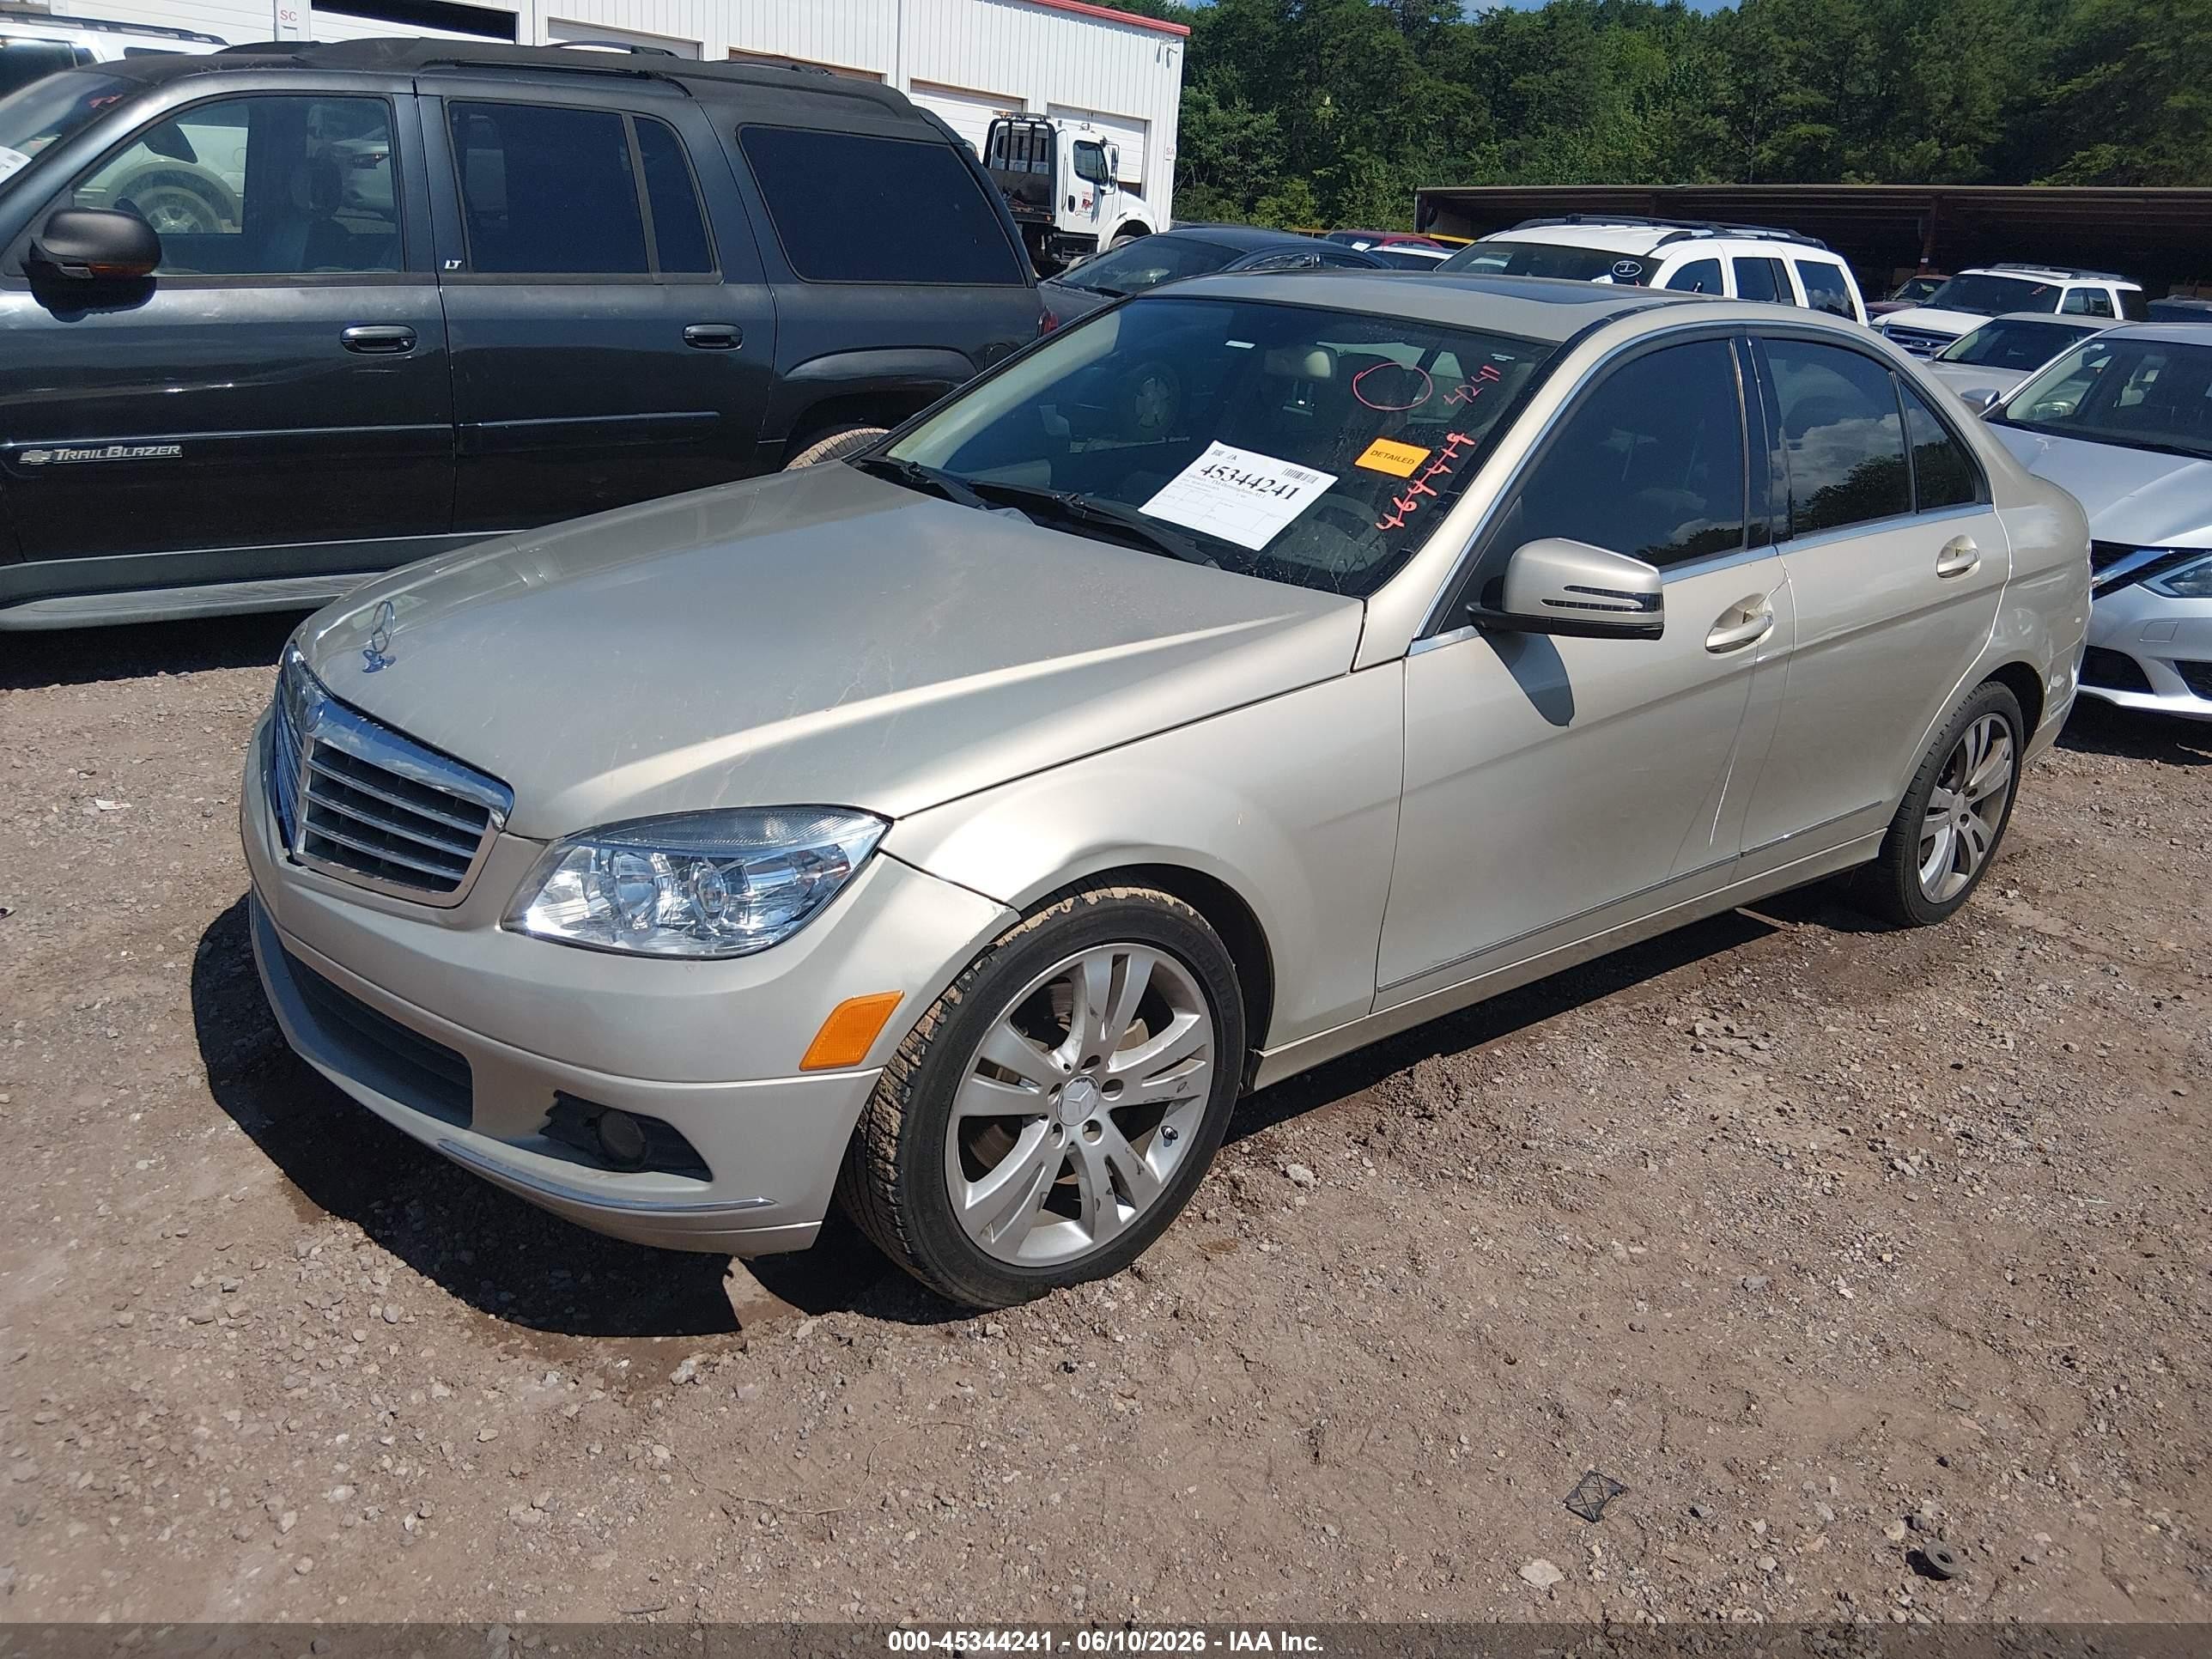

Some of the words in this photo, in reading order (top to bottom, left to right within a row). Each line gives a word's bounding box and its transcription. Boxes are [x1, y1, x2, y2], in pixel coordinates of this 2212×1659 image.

[280, 9, 297, 22] SC
[444, 259, 463, 270] LT
[1370, 449, 1416, 466] DETAILED
[1200, 464, 1301, 500] 45344241
